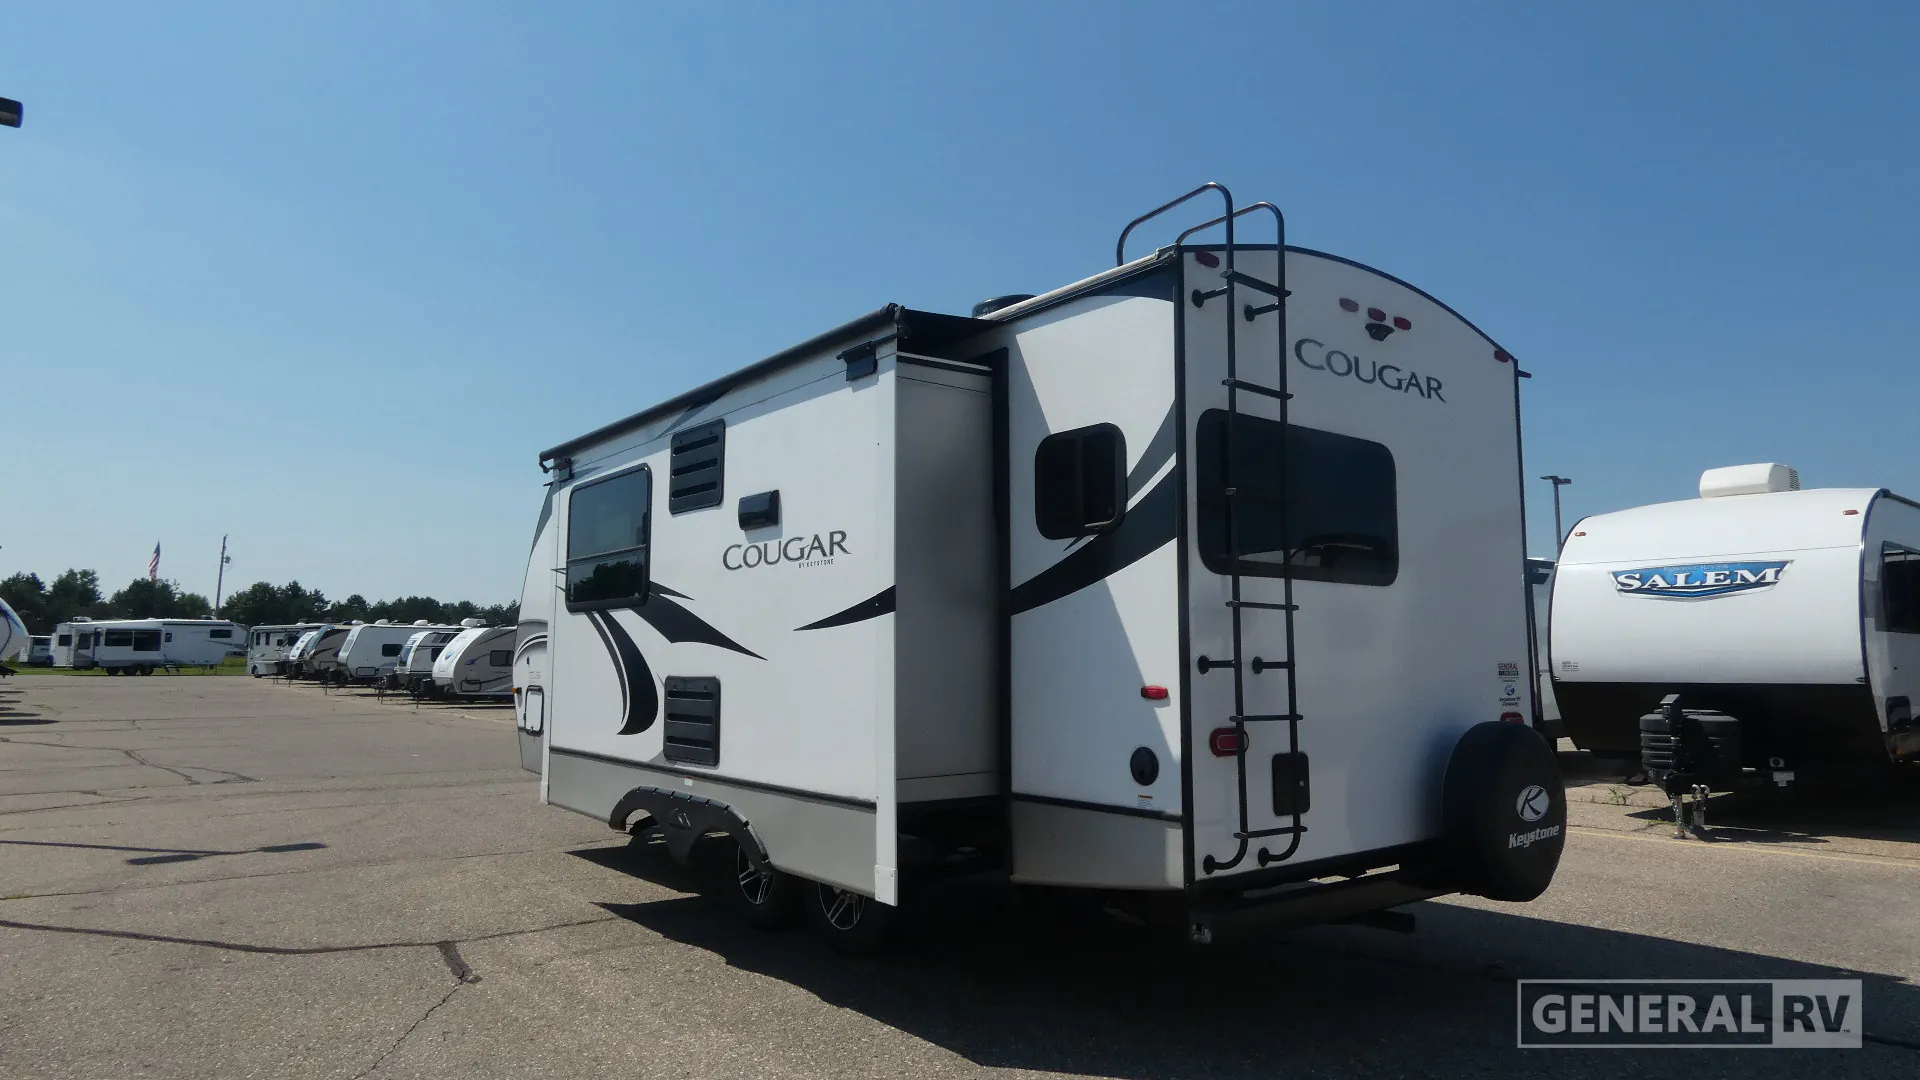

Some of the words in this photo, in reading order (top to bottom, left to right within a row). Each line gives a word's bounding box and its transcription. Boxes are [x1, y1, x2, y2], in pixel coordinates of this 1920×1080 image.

[1294, 338, 1448, 404] COUGAR
[722, 530, 852, 571] COUGAR
[1616, 567, 1781, 591] SALEM
[1508, 825, 1560, 849] Keystone
